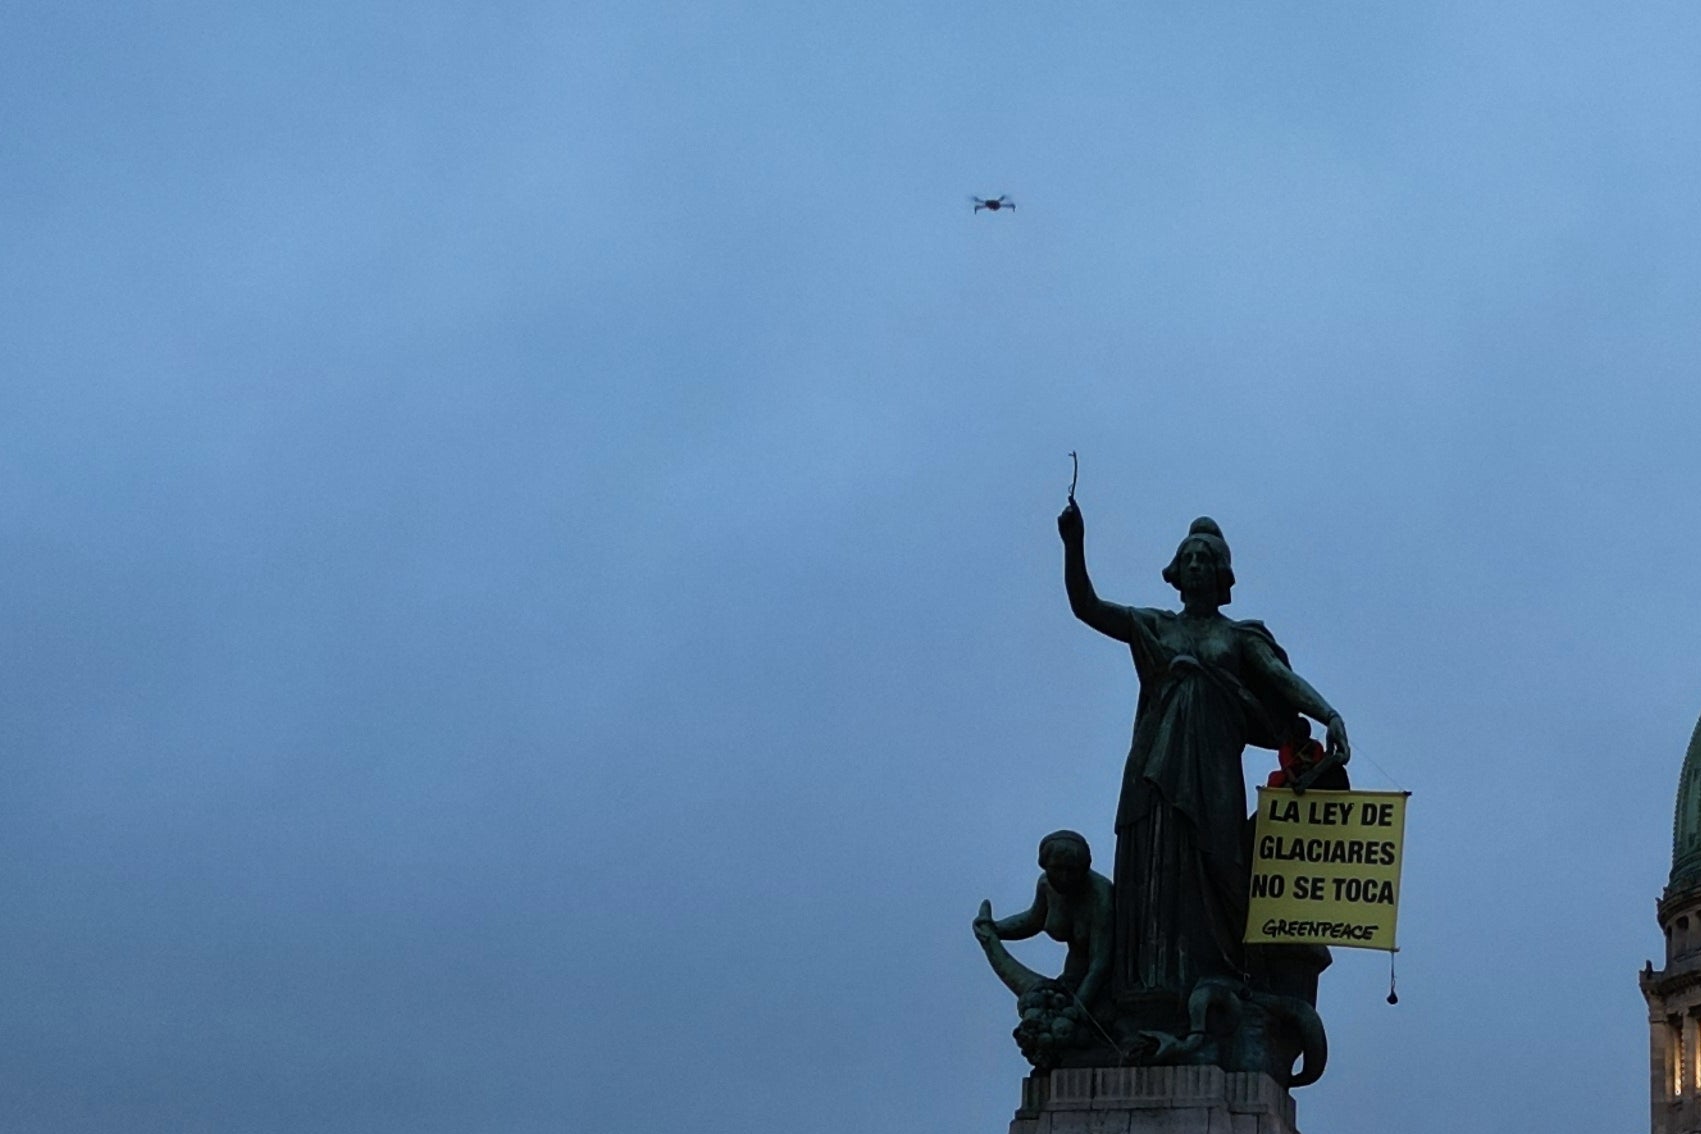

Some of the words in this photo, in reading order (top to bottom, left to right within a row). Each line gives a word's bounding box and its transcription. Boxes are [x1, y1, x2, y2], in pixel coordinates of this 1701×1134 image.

[1269, 800, 1299, 822] LA
[1308, 802, 1354, 824] LEY
[1361, 803, 1393, 826] DE
[1259, 836, 1395, 865] GLACIARES
[1251, 874, 1285, 898] NO
[1293, 876, 1325, 900] SE
[1332, 878, 1394, 904] TOCA
[1262, 919, 1378, 940] GREENPEACE
